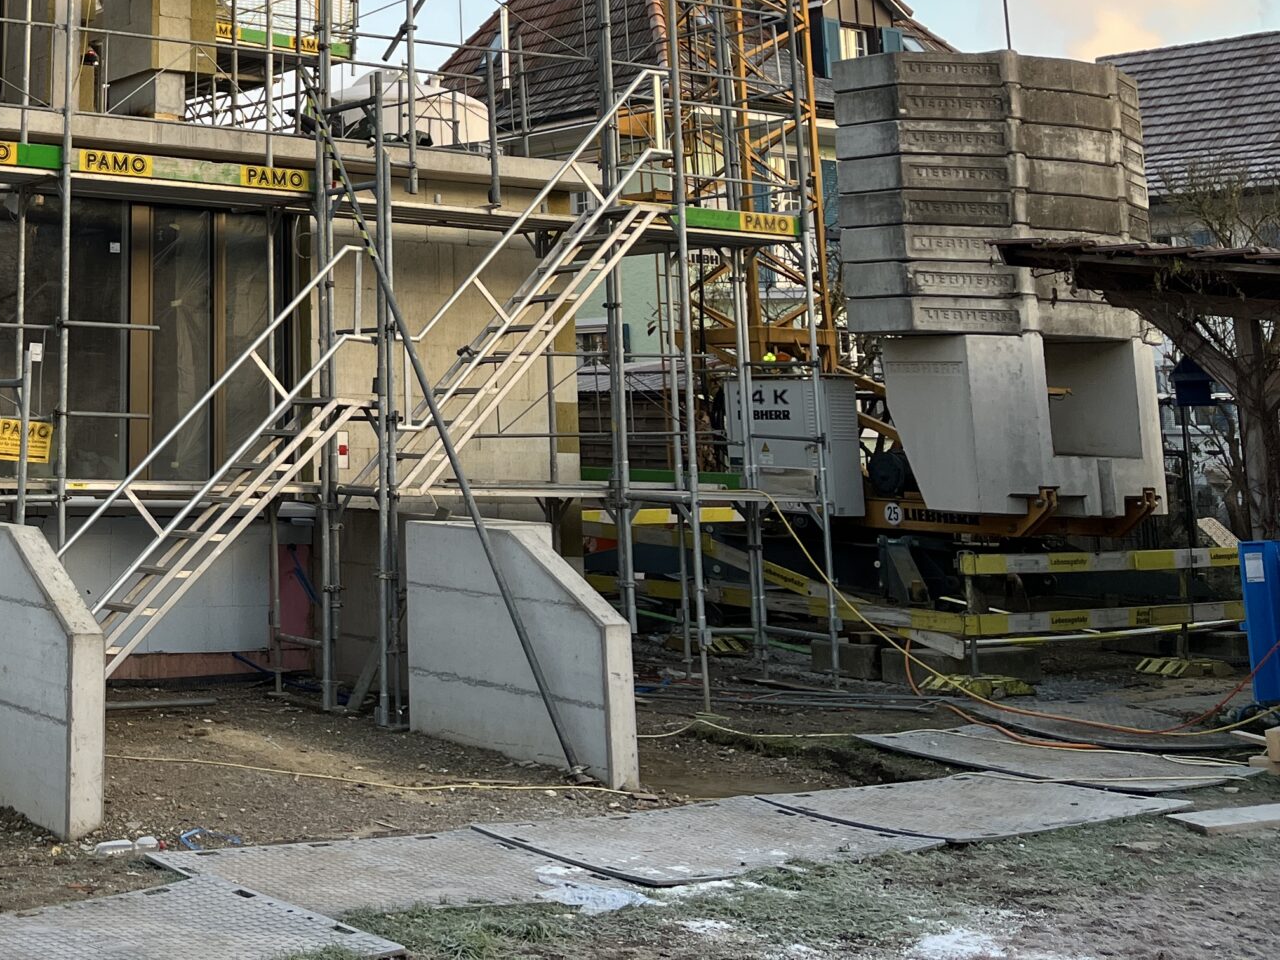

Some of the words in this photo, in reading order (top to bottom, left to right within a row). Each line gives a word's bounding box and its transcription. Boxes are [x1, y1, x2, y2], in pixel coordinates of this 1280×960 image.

[85, 152, 146, 173] PAMO
[247, 169, 303, 188] PAMO
[745, 215, 788, 232] PAMO
[773, 389, 790, 405] K
[887, 506, 899, 522] 25
